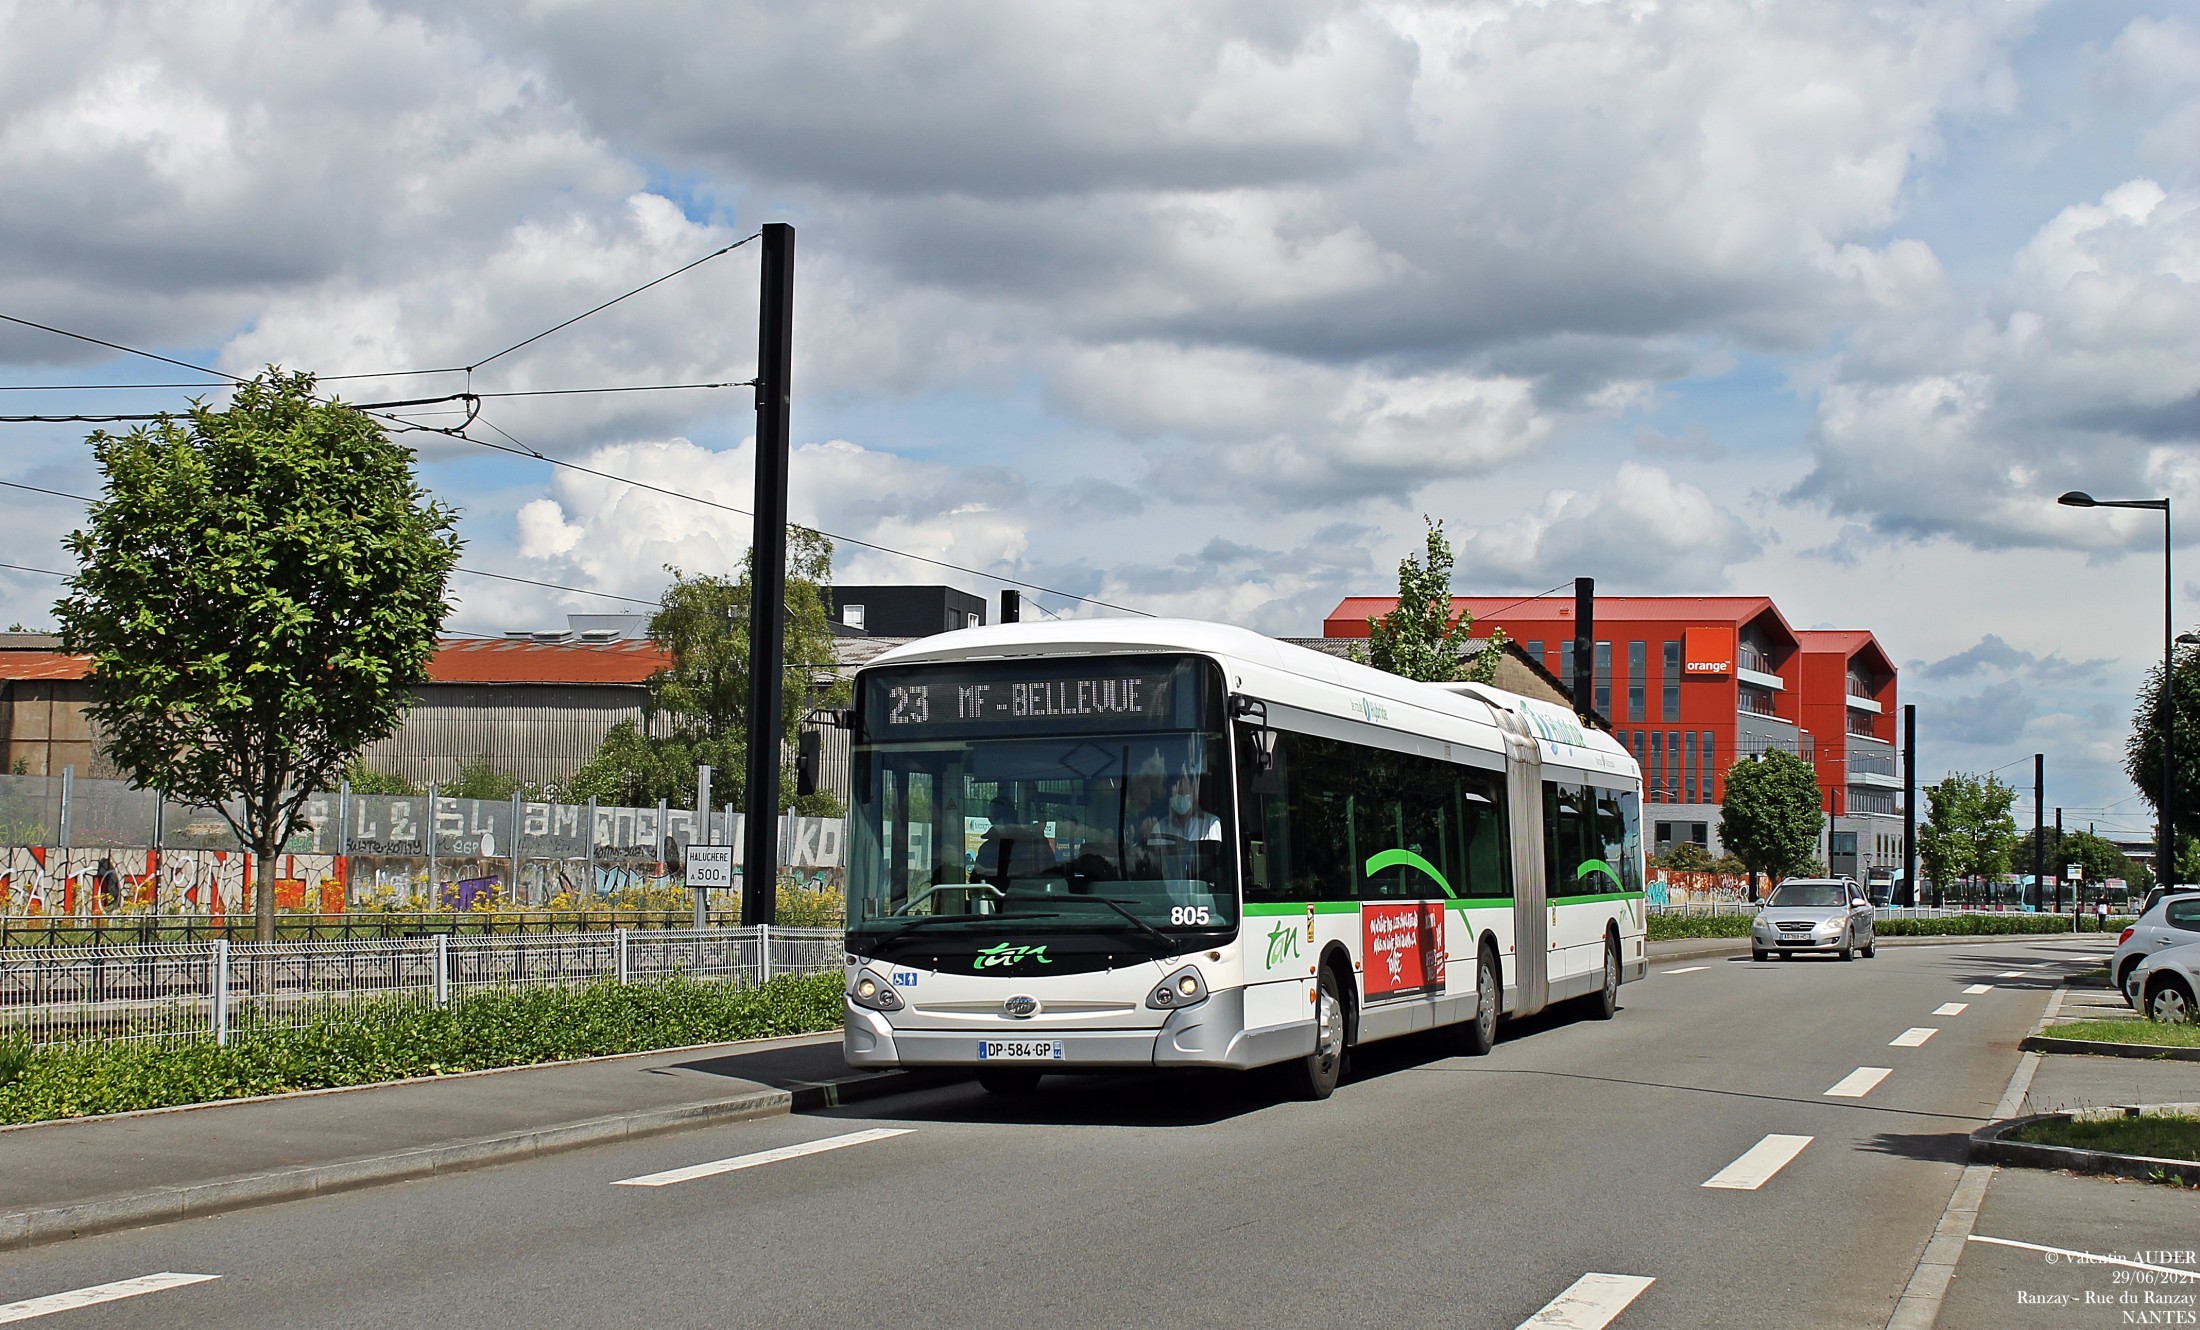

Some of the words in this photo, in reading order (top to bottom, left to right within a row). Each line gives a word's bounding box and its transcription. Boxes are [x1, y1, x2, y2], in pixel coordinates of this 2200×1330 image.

[1687, 662, 1727, 672] orange
[889, 685, 929, 724] 23
[690, 852, 728, 862] HALUCHERE
[697, 868, 720, 880] 500
[1171, 906, 1210, 925] 805
[1266, 920, 1301, 970] tan
[973, 942, 1053, 969] tan
[988, 1043, 1051, 1057] DP-584-GP
